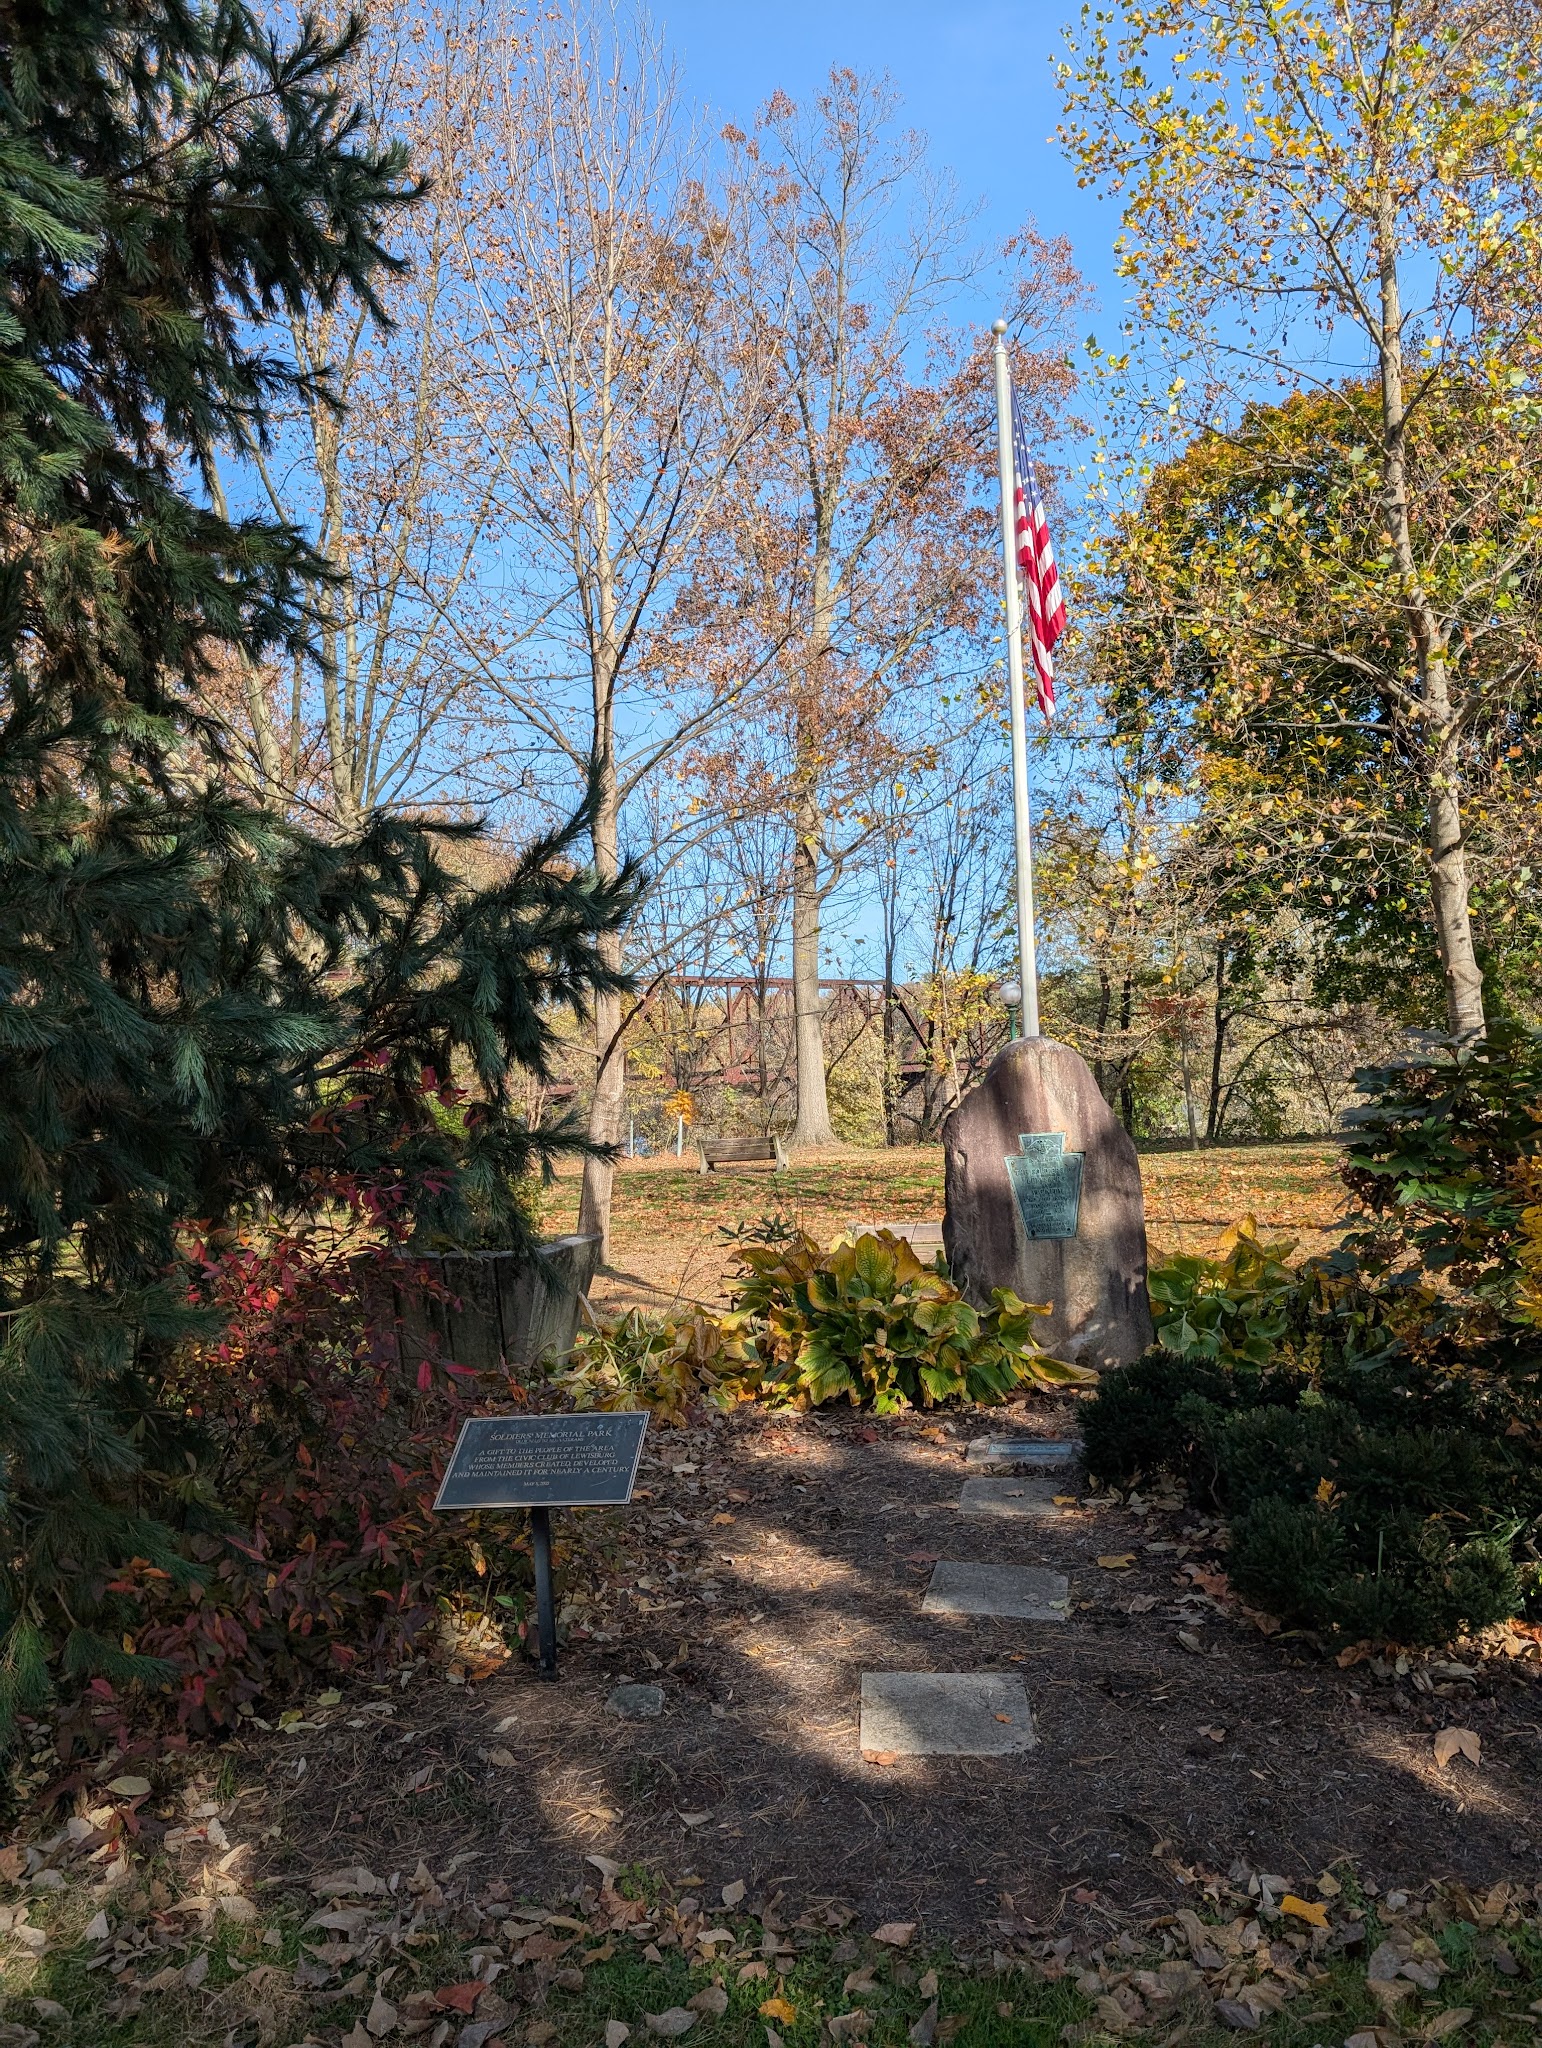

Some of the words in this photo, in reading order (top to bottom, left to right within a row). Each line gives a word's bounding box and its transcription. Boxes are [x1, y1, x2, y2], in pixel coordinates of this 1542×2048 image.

[535, 1431, 585, 1439] MEMORIAL
[573, 1459, 618, 1467] DEVELOPED
[550, 1467, 582, 1475] NEARLY
